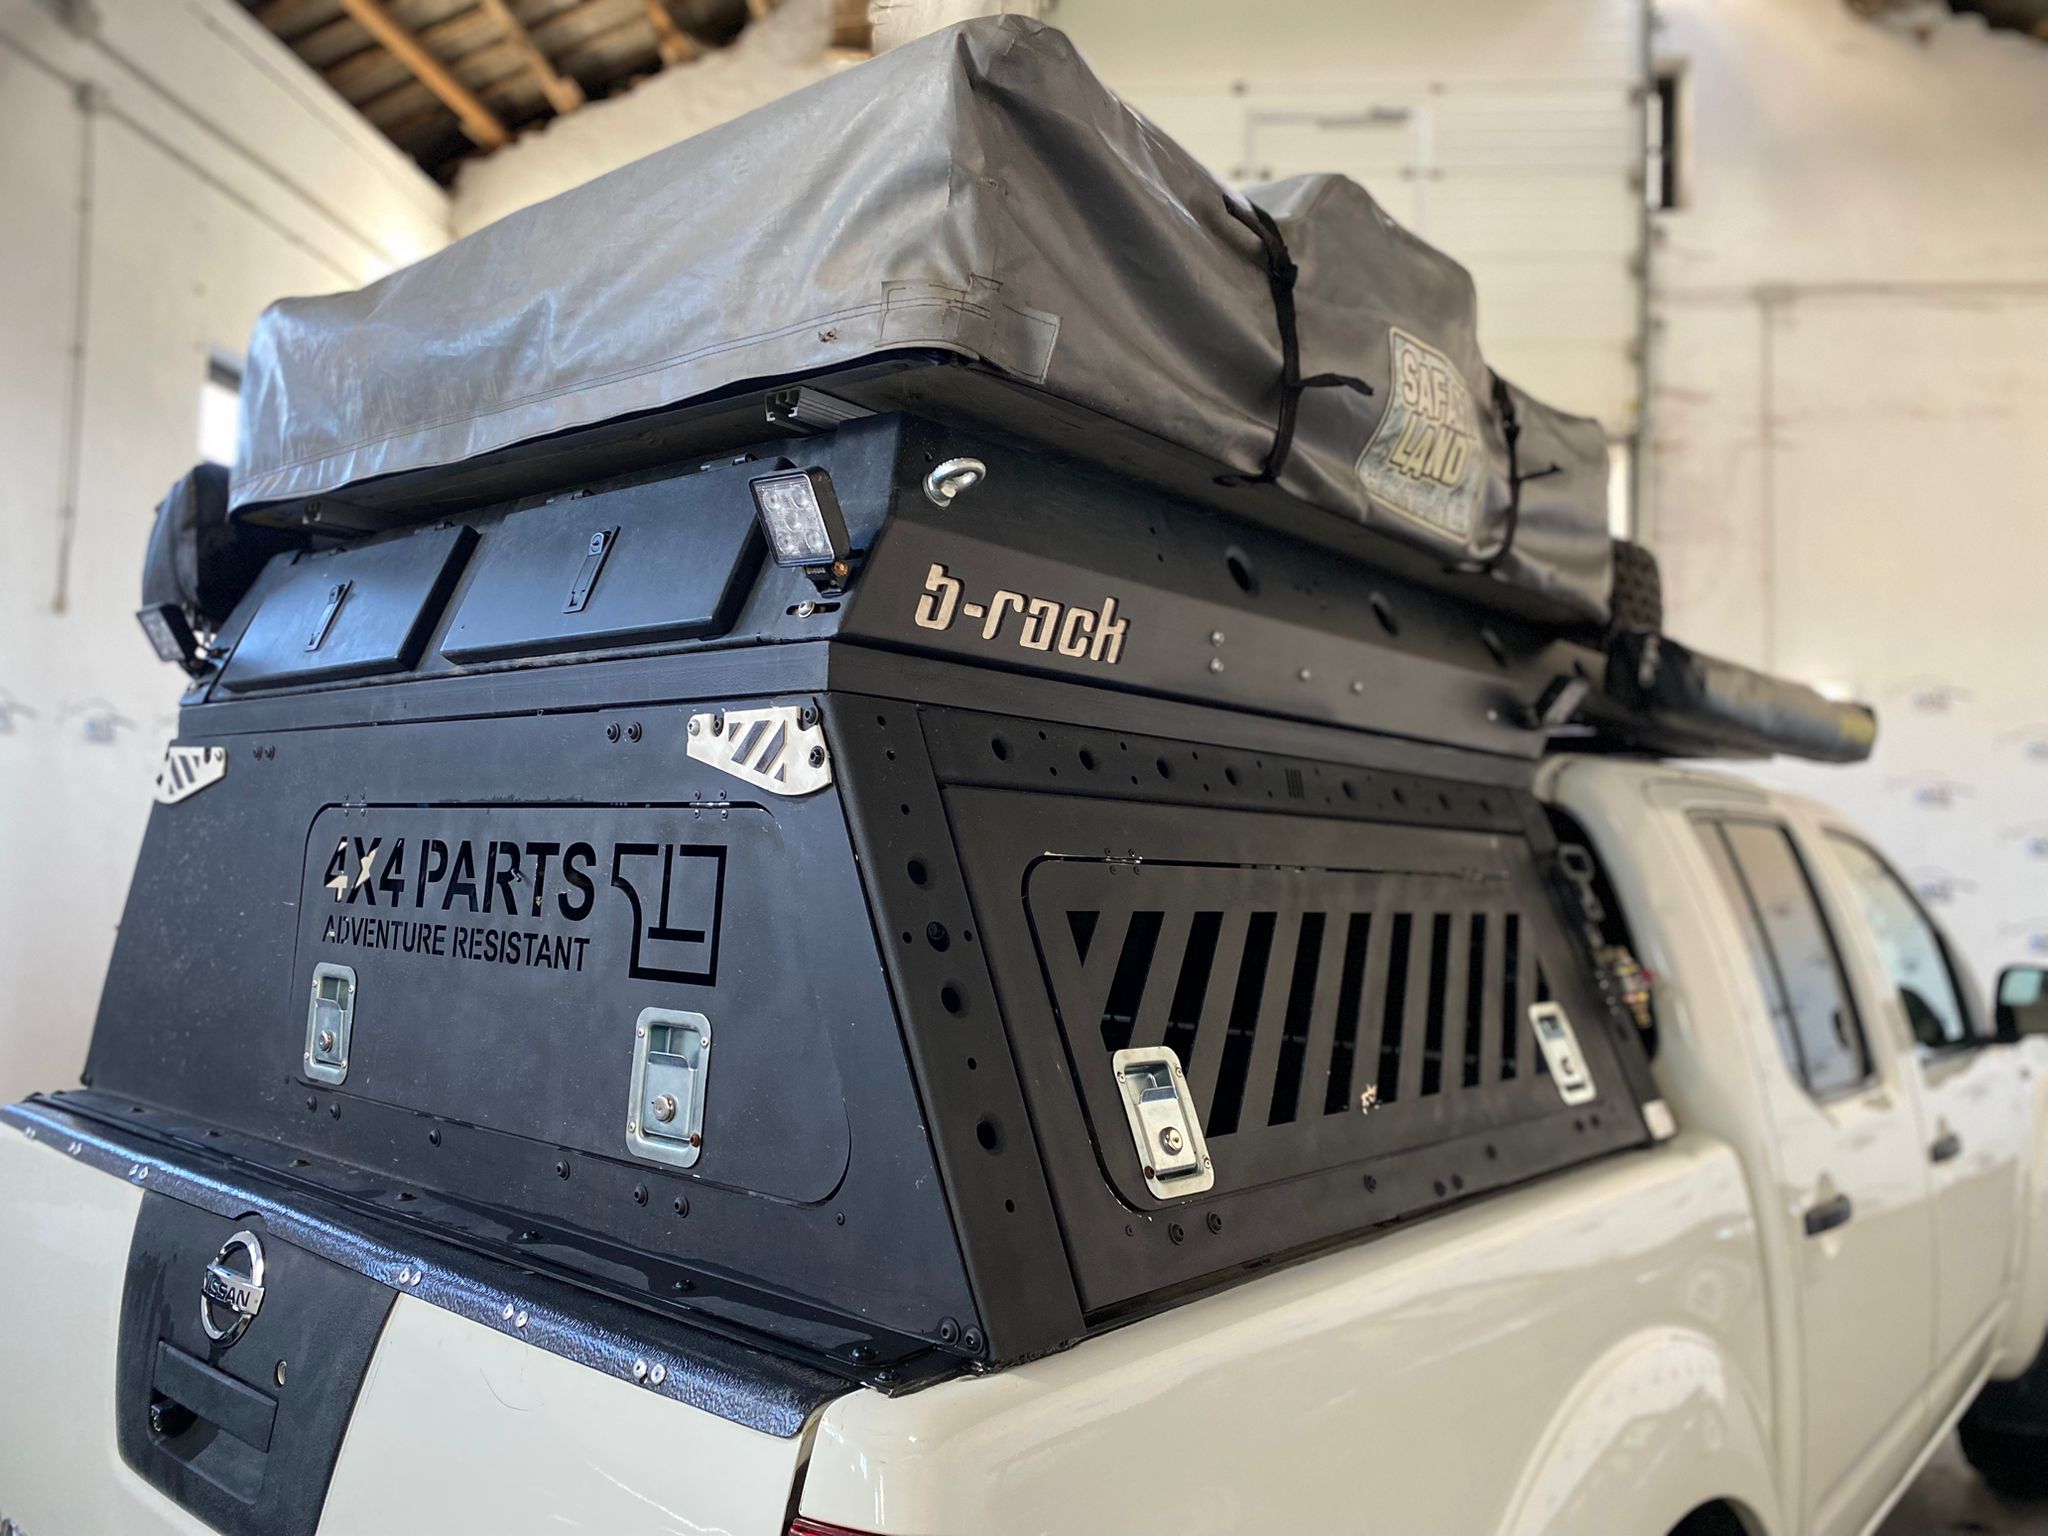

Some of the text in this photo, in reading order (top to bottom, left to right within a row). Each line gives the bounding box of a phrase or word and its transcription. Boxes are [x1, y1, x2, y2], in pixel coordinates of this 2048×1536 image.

[1388, 410, 1470, 487] LAND
[322, 914, 591, 972] ADVENTURE RESISTANT
